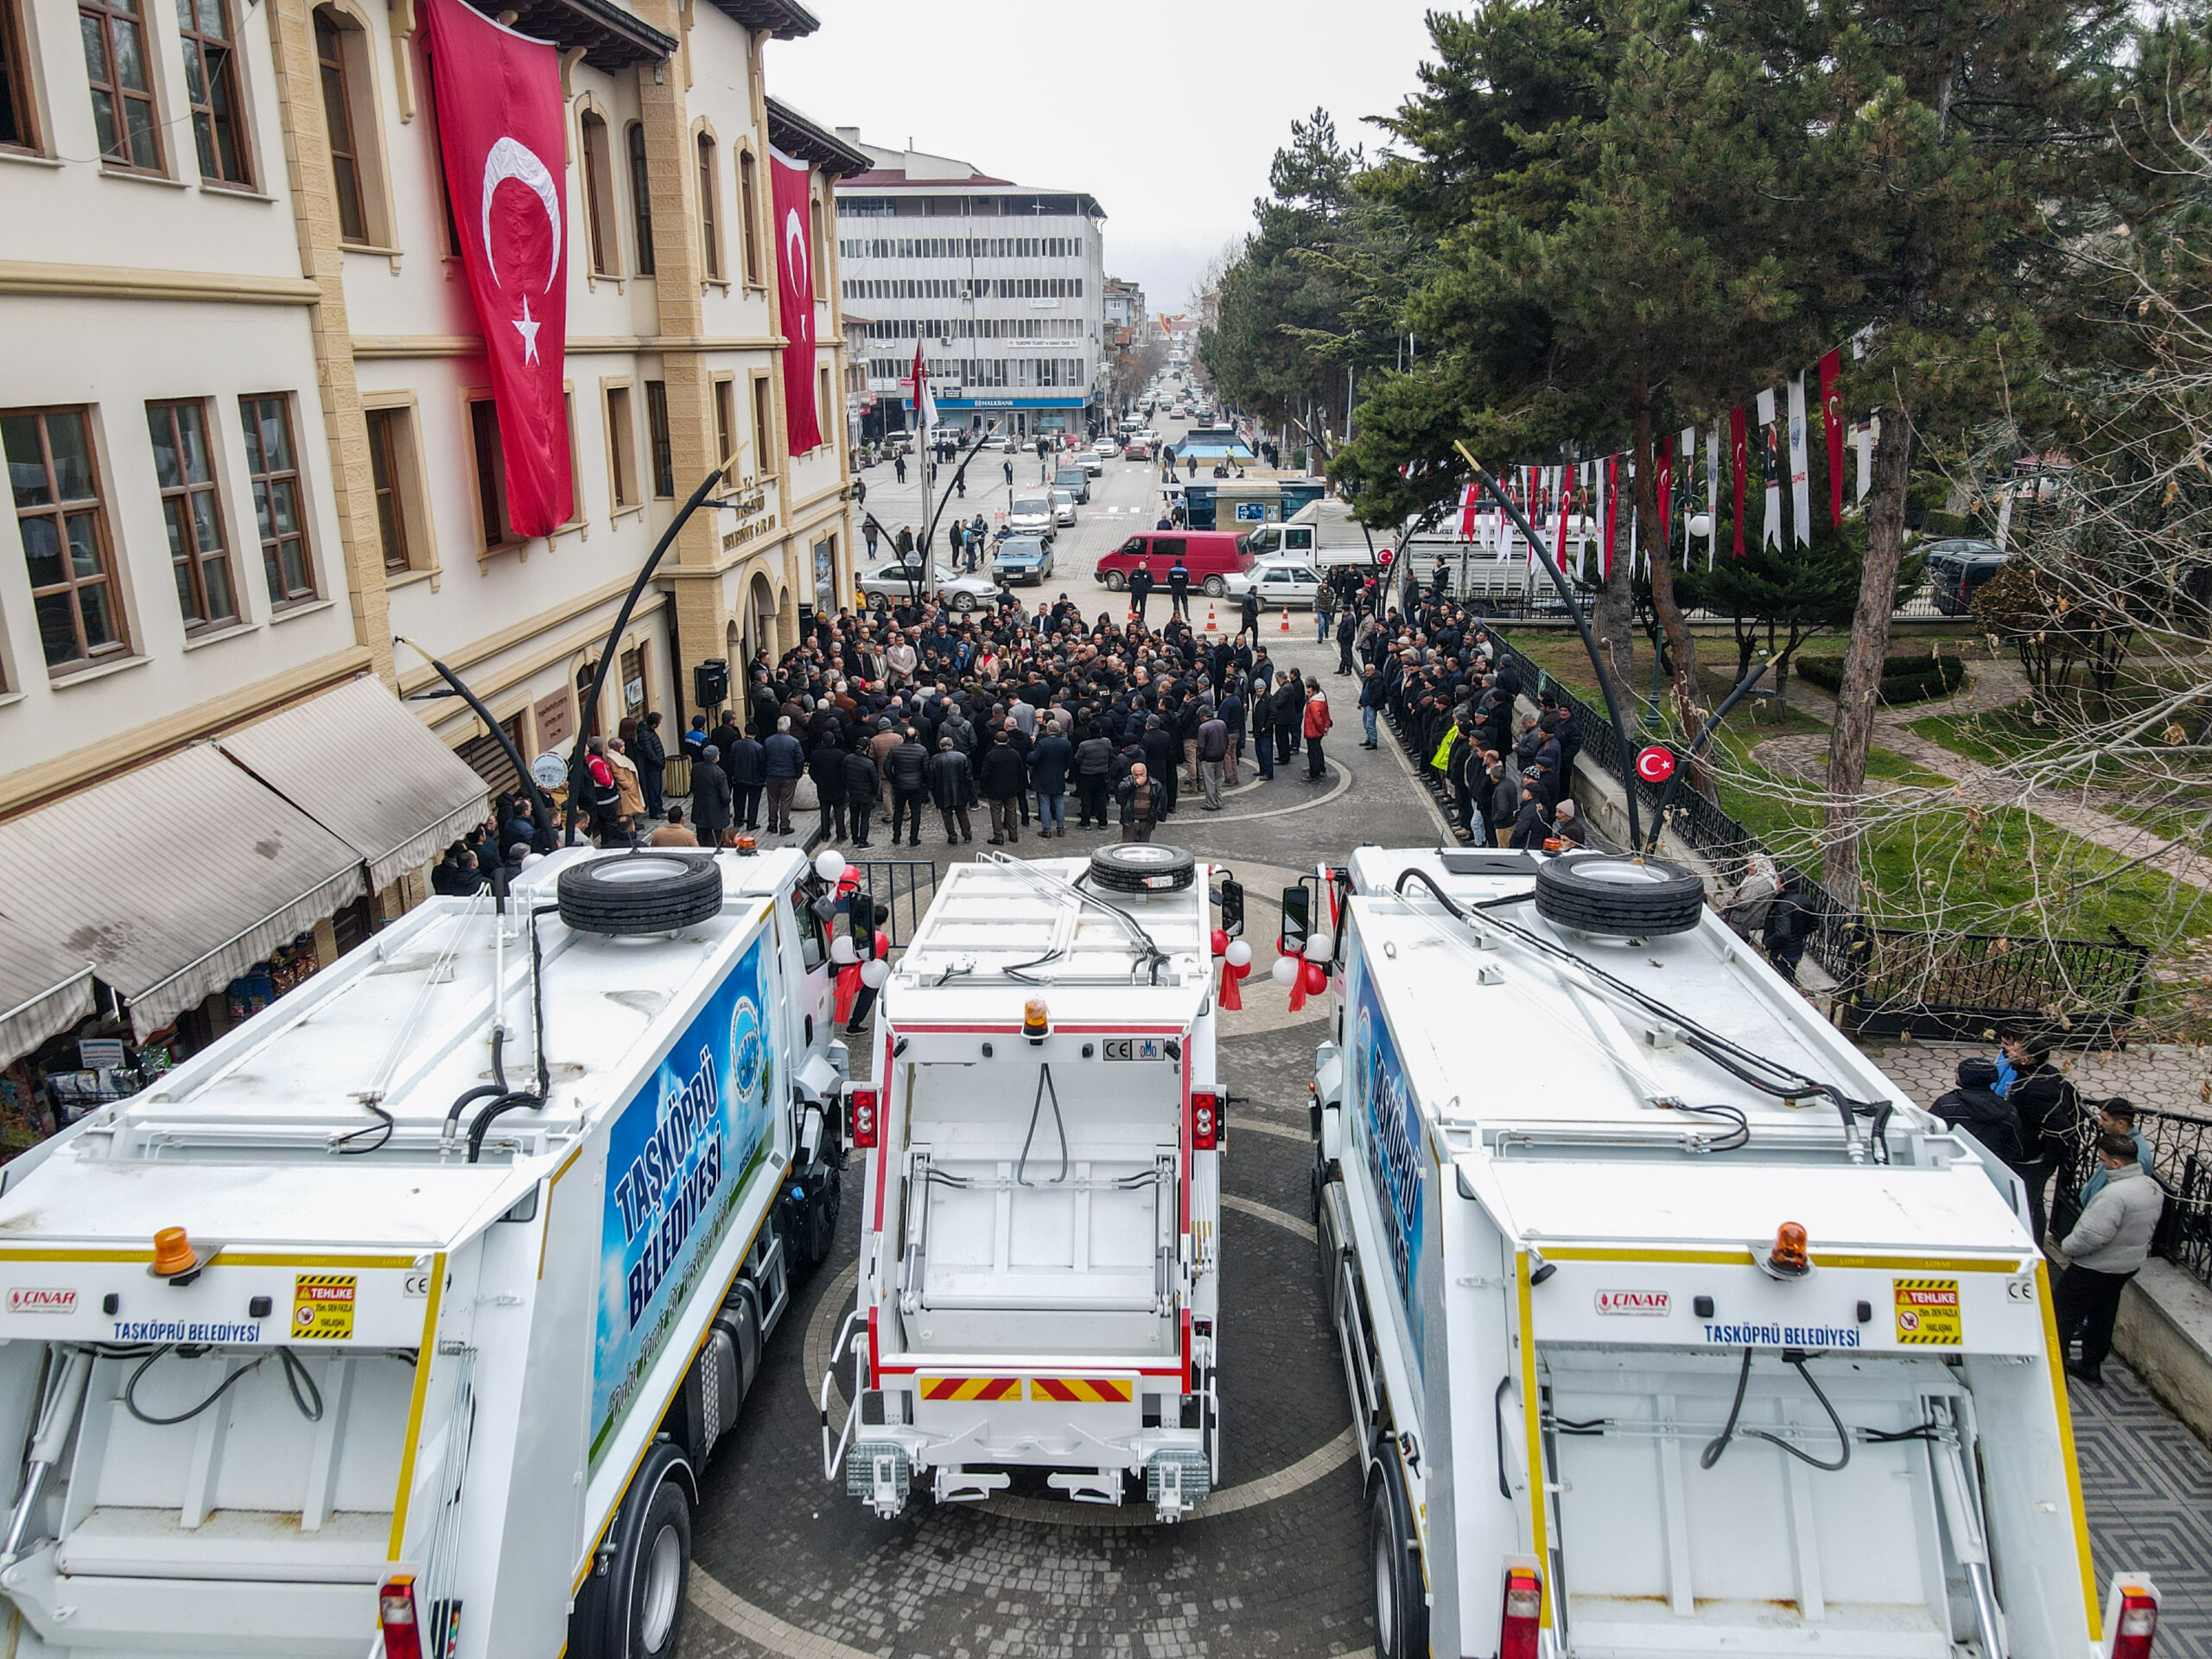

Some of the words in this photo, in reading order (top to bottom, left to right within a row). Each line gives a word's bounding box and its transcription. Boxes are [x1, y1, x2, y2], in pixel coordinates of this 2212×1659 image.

[1106, 1042, 1128, 1058] CE
[1140, 1039, 1157, 1057] DMO
[614, 1044, 718, 1246] TAŞKÖPRÜ
[1370, 1042, 1422, 1231] TAŞKÖPRÜ
[627, 1120, 722, 1334] BELEDİYESİ
[406, 1277, 428, 1294] CE
[2008, 1282, 2031, 1299] CE
[23, 1291, 76, 1306] ÇINAR
[1613, 1293, 1668, 1309] ÇINAR
[188, 1320, 260, 1342] BELEDİYESİ
[1784, 1324, 1860, 1347] BELEDİYESİ
